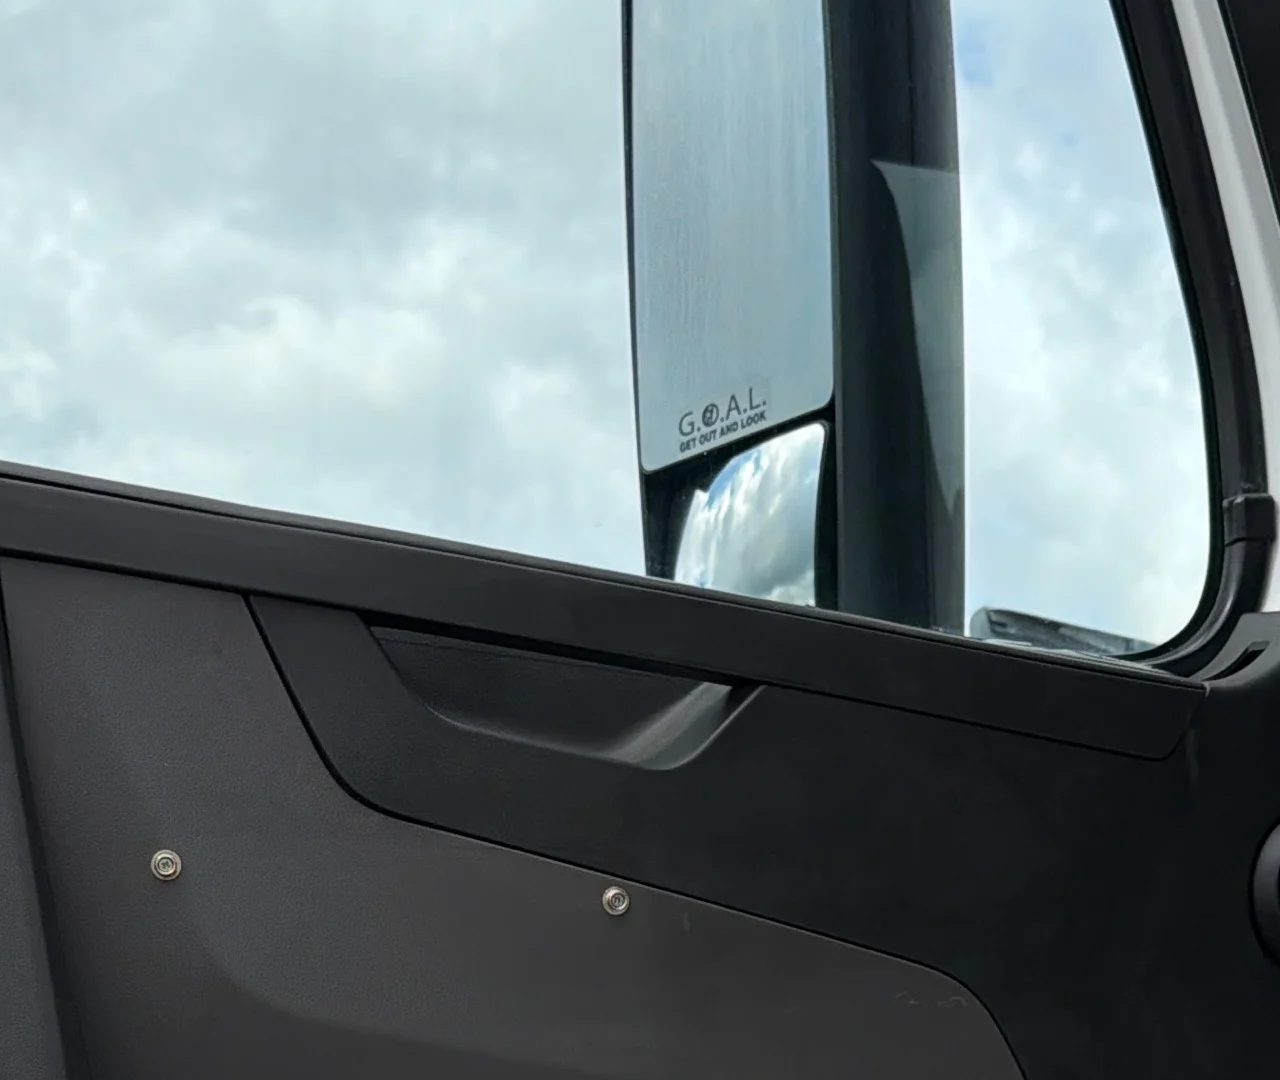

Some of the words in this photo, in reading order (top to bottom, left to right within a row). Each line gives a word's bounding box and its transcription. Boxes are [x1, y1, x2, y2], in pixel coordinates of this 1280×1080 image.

[680, 437, 696, 452] GET
[699, 429, 717, 445] OUT
[720, 421, 739, 437] AND
[740, 411, 766, 430] LOOK
